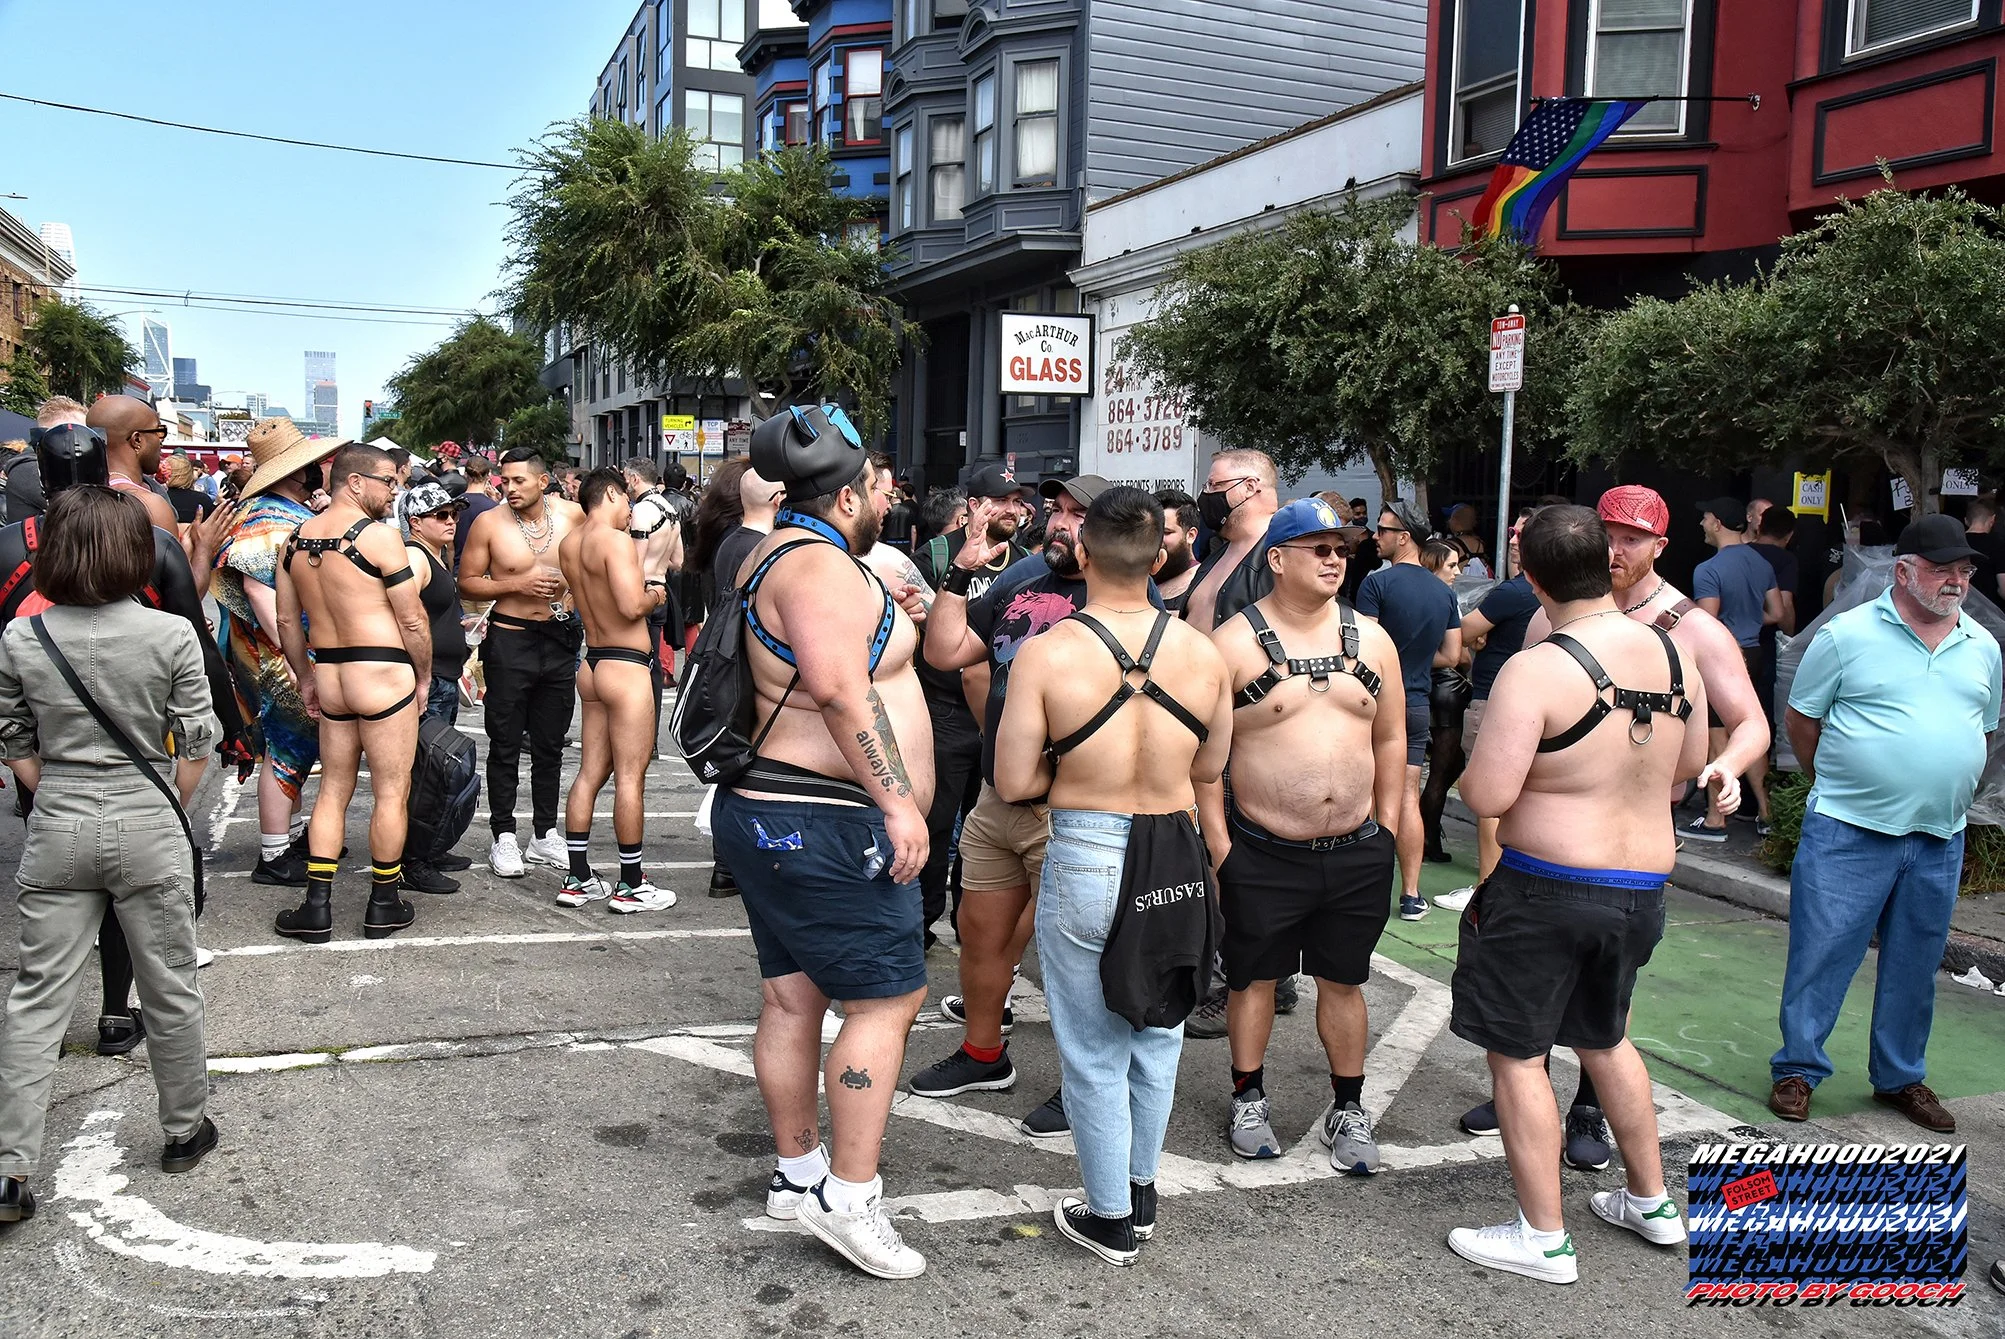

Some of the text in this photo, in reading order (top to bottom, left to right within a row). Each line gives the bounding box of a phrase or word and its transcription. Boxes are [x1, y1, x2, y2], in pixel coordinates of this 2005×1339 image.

[1492, 331, 1522, 348] NO PARKING
[1495, 350, 1517, 361] ANY TIME
[1009, 355, 1082, 383] GLASS
[1495, 361, 1516, 371] EXCEPT
[1492, 371, 1519, 381] MOTORCYCLES
[1155, 479, 1185, 492] MIRRORS
[1802, 482, 1823, 493] CASH
[1801, 495, 1823, 504] ONLY
[856, 730, 894, 792] always.
